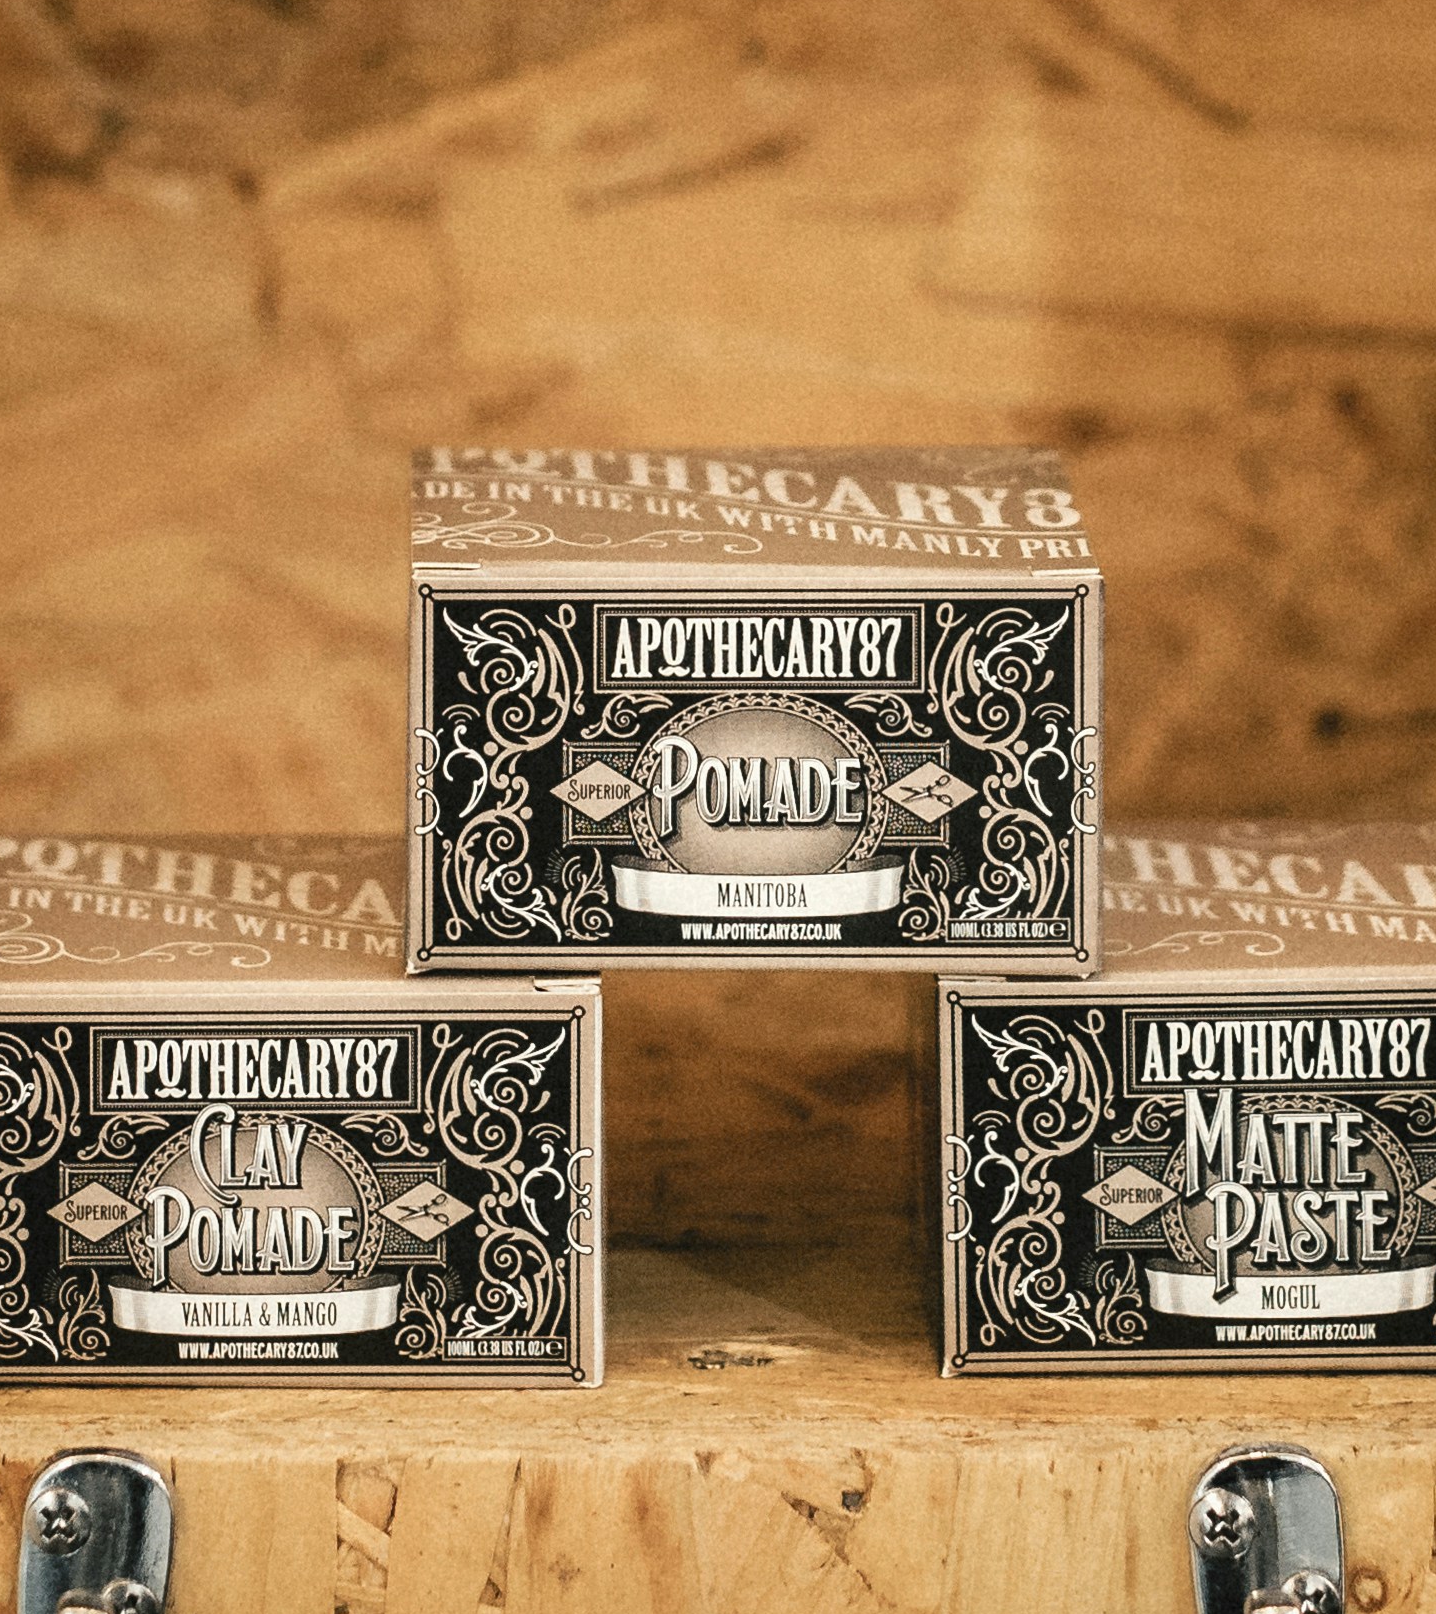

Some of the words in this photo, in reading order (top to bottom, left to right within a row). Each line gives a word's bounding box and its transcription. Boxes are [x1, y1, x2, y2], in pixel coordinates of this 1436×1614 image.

[543, 484, 634, 513] THE
[644, 495, 702, 521] UK
[717, 505, 838, 542] WITH
[852, 524, 1003, 558] MANLY
[1019, 537, 1092, 559] PRI
[611, 616, 903, 679] APOTHECARY87
[567, 778, 632, 802] SUPERIOR
[652, 735, 863, 838] POMADE
[8, 886, 54, 910] IN
[66, 890, 153, 920] THE
[163, 902, 218, 931] UK
[233, 912, 350, 951] WITH
[717, 882, 809, 908] MANITOBA
[1227, 899, 1359, 935] WITH
[680, 922, 842, 942] WWW.APOTHECARY87.CO.UK
[108, 1038, 398, 1100] APOTHECARY87
[1141, 1017, 1431, 1083] APOTHECARY87
[189, 1103, 307, 1204] CLAY
[1182, 1088, 1366, 1198] MATTE
[63, 1199, 128, 1223] SUPERIOR
[1099, 1183, 1164, 1207] SUPERIOR
[146, 1185, 359, 1288] POMADE
[1204, 1181, 1392, 1300] PASTE
[181, 1301, 253, 1328] VANILLA
[258, 1301, 272, 1328] &
[276, 1301, 338, 1327] MANGO
[1261, 1284, 1321, 1310] MOGUL
[178, 1342, 339, 1360] WWW.APOTHECARY87.CO.UK
[1215, 1323, 1377, 1342] WWW.APOTHECARY87.CO.UK
